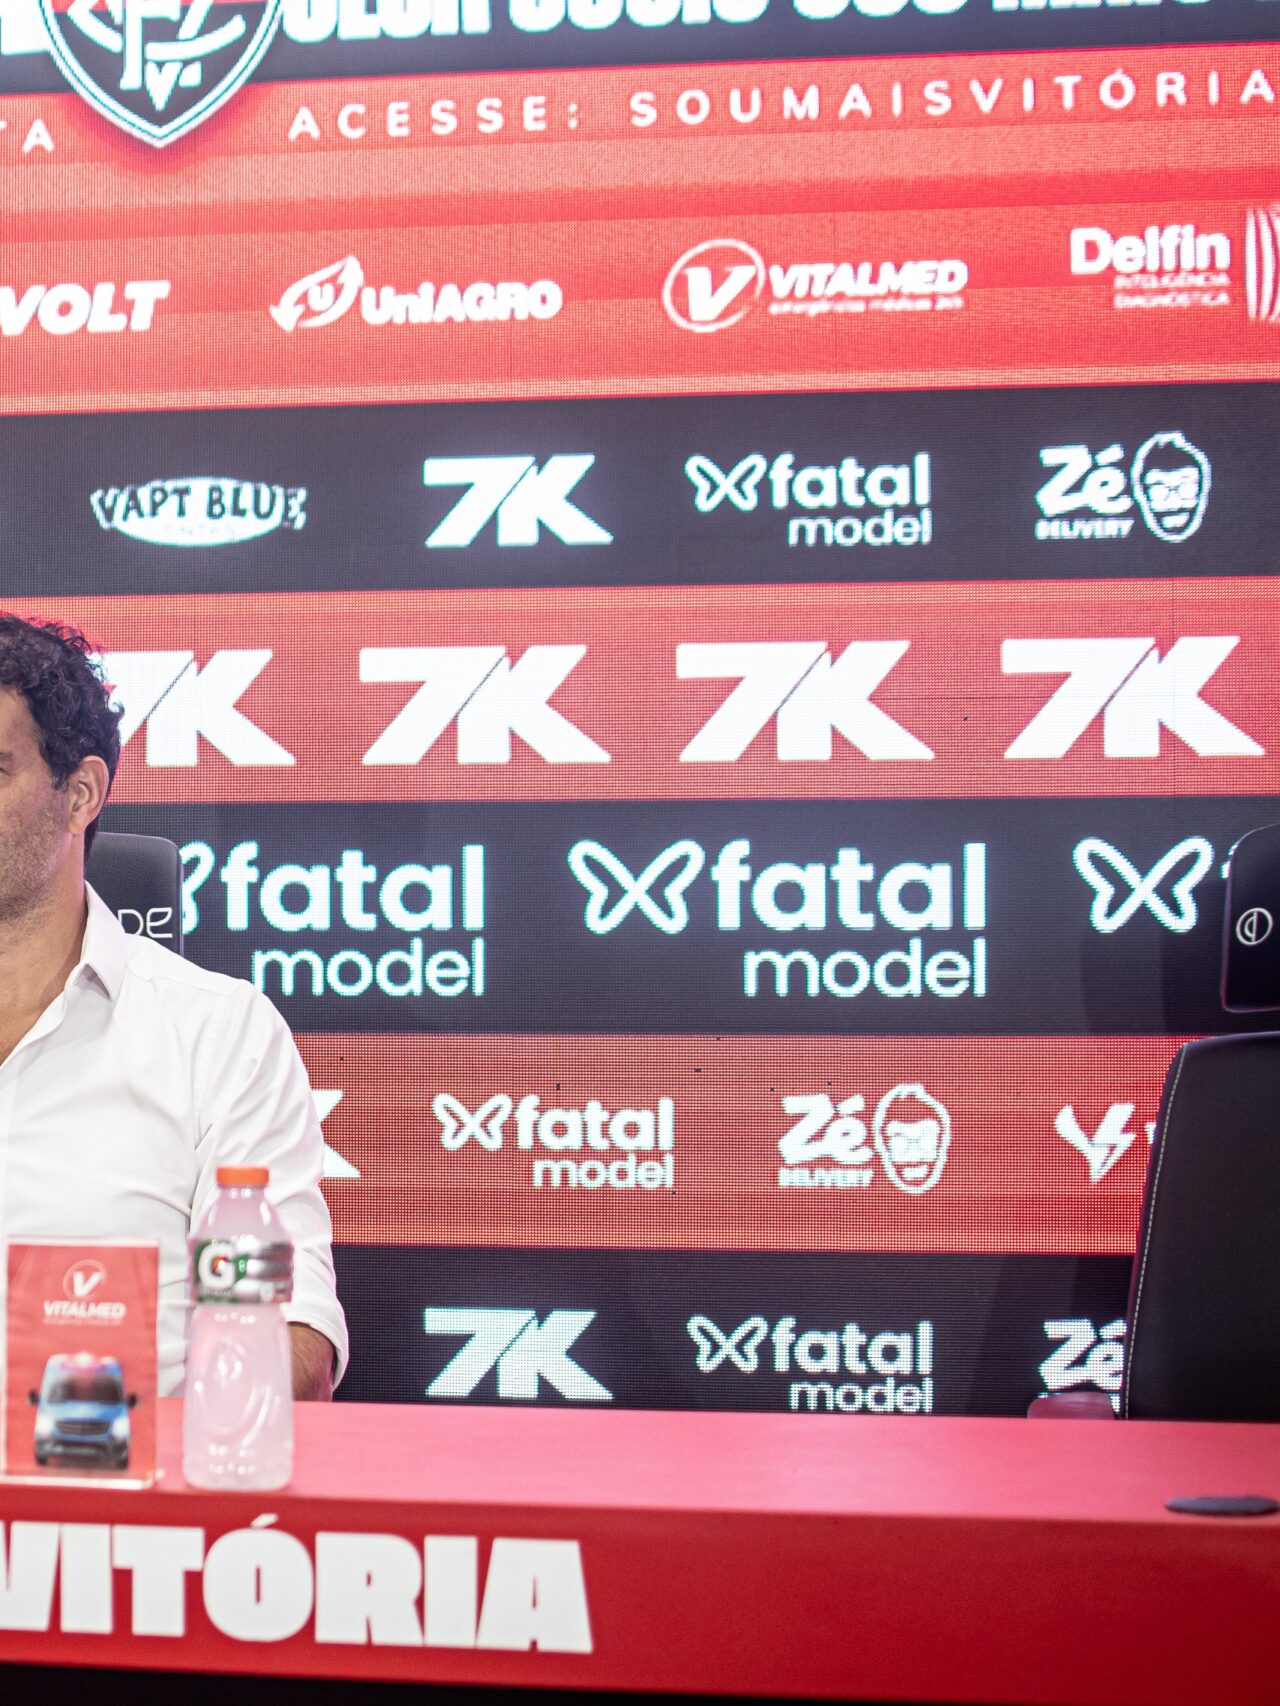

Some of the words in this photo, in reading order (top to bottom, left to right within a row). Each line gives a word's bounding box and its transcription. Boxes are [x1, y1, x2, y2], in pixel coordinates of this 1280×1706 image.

[287, 87, 579, 143] ACESSE:
[629, 68, 1275, 128] SOUMAISVITÓRIA
[1069, 223, 1232, 276] Delfin
[768, 259, 968, 301] VITALMED
[91, 485, 192, 528] VAPT
[206, 483, 308, 529] BLUE
[424, 454, 613, 548] 7K
[769, 452, 932, 508] fatal
[1035, 443, 1134, 517] Zé
[787, 508, 933, 547] model
[358, 643, 613, 767] 7K
[674, 639, 936, 764] 7K
[999, 635, 1266, 760] 7K
[220, 840, 485, 932] fatal
[712, 840, 985, 931] fatal
[251, 937, 487, 997] model
[745, 938, 986, 997] model
[513, 1093, 675, 1153] fatal
[778, 1092, 874, 1166] Zé
[532, 1151, 675, 1190] model
[43, 1300, 127, 1319] VITALMED
[425, 1308, 612, 1400] 7K
[772, 1316, 933, 1375] fatal
[1038, 1317, 1127, 1391] Zé
[789, 1377, 934, 1413] model
